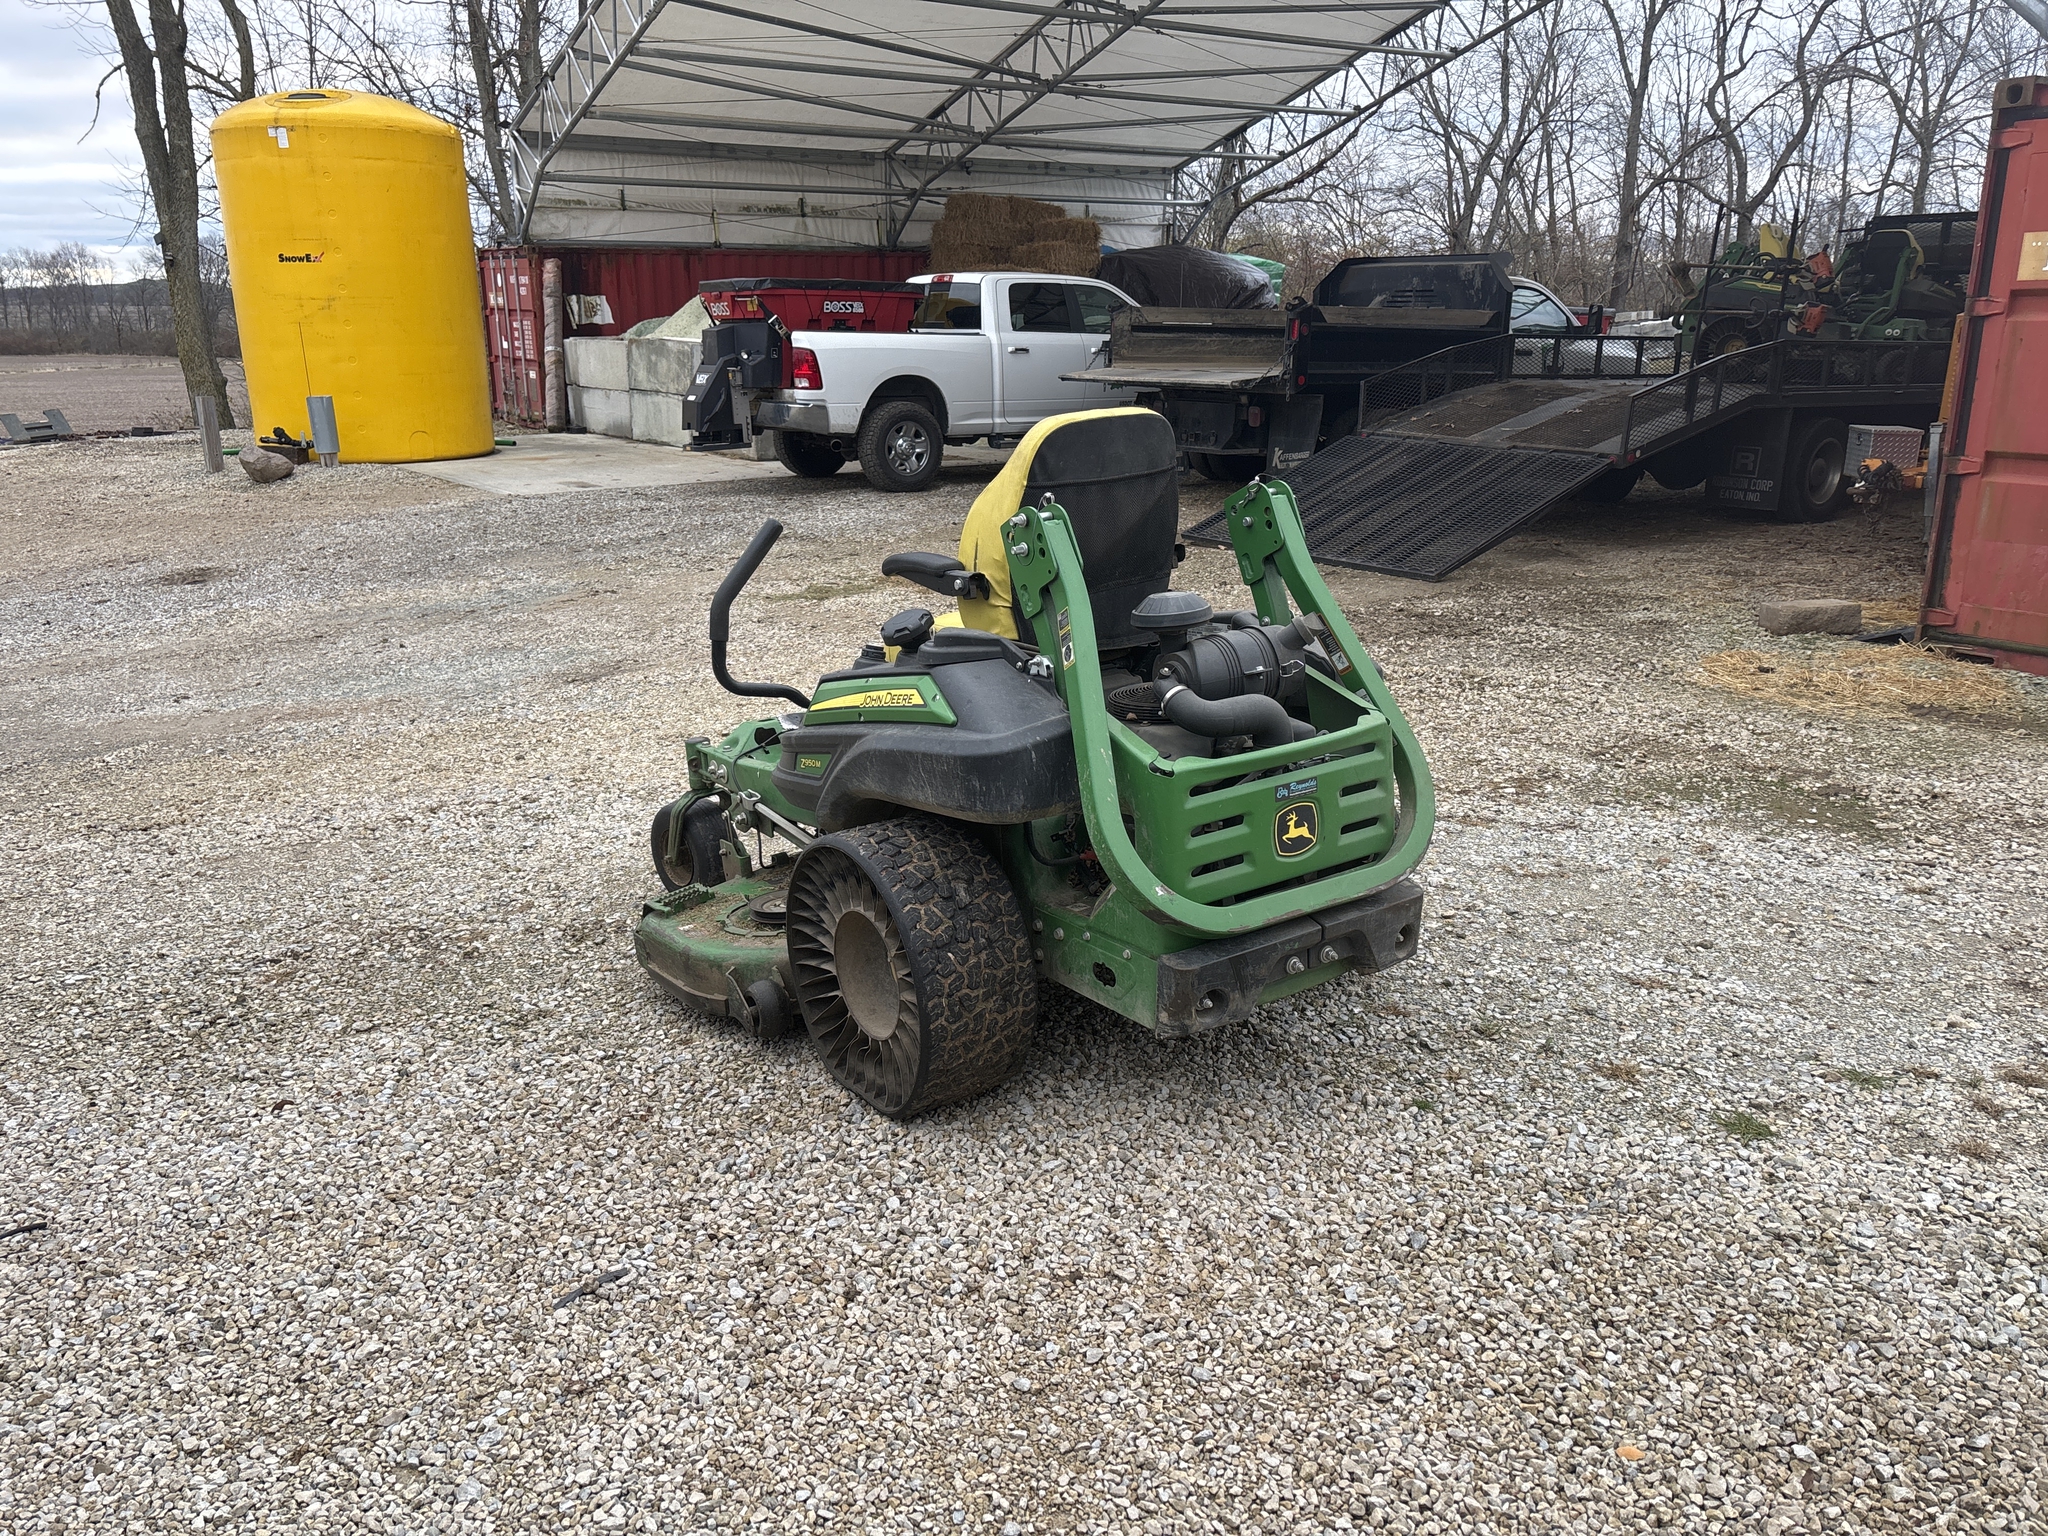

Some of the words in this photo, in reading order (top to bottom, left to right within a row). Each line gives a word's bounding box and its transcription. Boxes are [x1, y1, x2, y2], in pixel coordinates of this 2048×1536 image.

[710, 302, 730, 316] BOSS
[824, 301, 852, 313] BOSS
[1750, 479, 1774, 492] CORP.
[860, 694, 884, 706] JOHN
[884, 692, 915, 705] DEERE
[800, 758, 821, 769] Z950M
